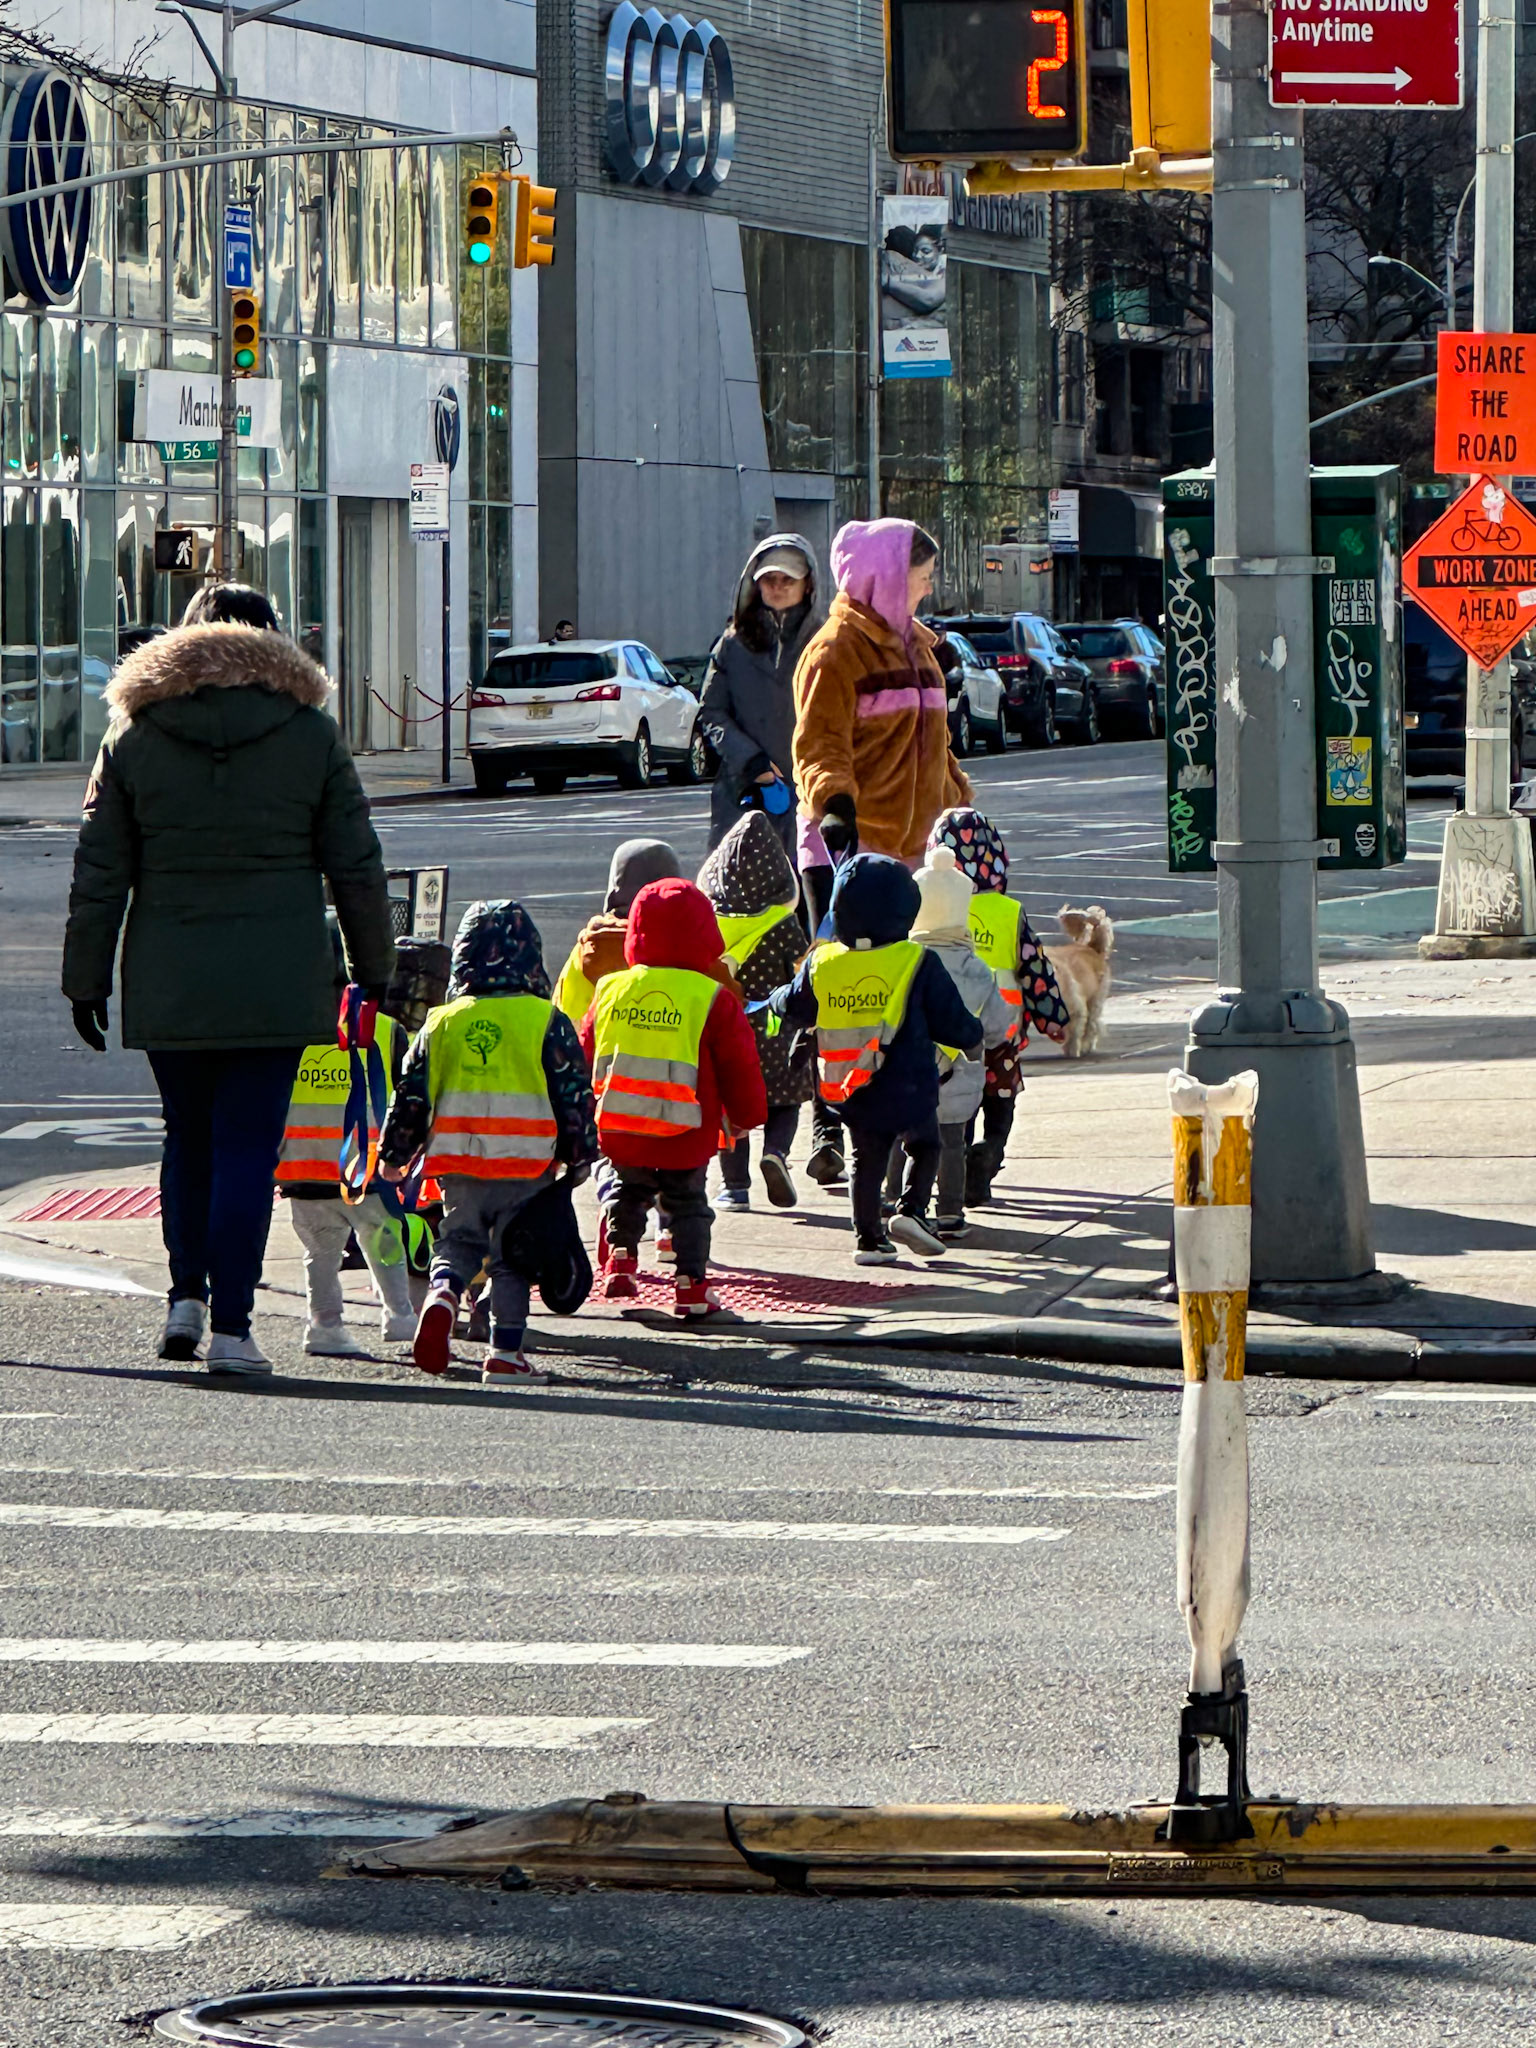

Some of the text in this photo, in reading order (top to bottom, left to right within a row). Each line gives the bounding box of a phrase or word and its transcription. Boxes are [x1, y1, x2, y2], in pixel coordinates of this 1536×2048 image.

[1282, 17, 1374, 47] Anytime
[1027, 9, 1069, 119] 2
[1455, 345, 1526, 374] SHARE
[1470, 389, 1508, 418] THE
[164, 443, 177, 460] W
[183, 443, 202, 459] 56
[1458, 433, 1517, 462] ROAD
[1433, 559, 1536, 584] WORK ZONE
[1458, 598, 1517, 622] AHEAD
[828, 989, 894, 1013] hopscotc
[611, 1005, 682, 1025] hopscotch
[299, 1068, 348, 1088] opsco
